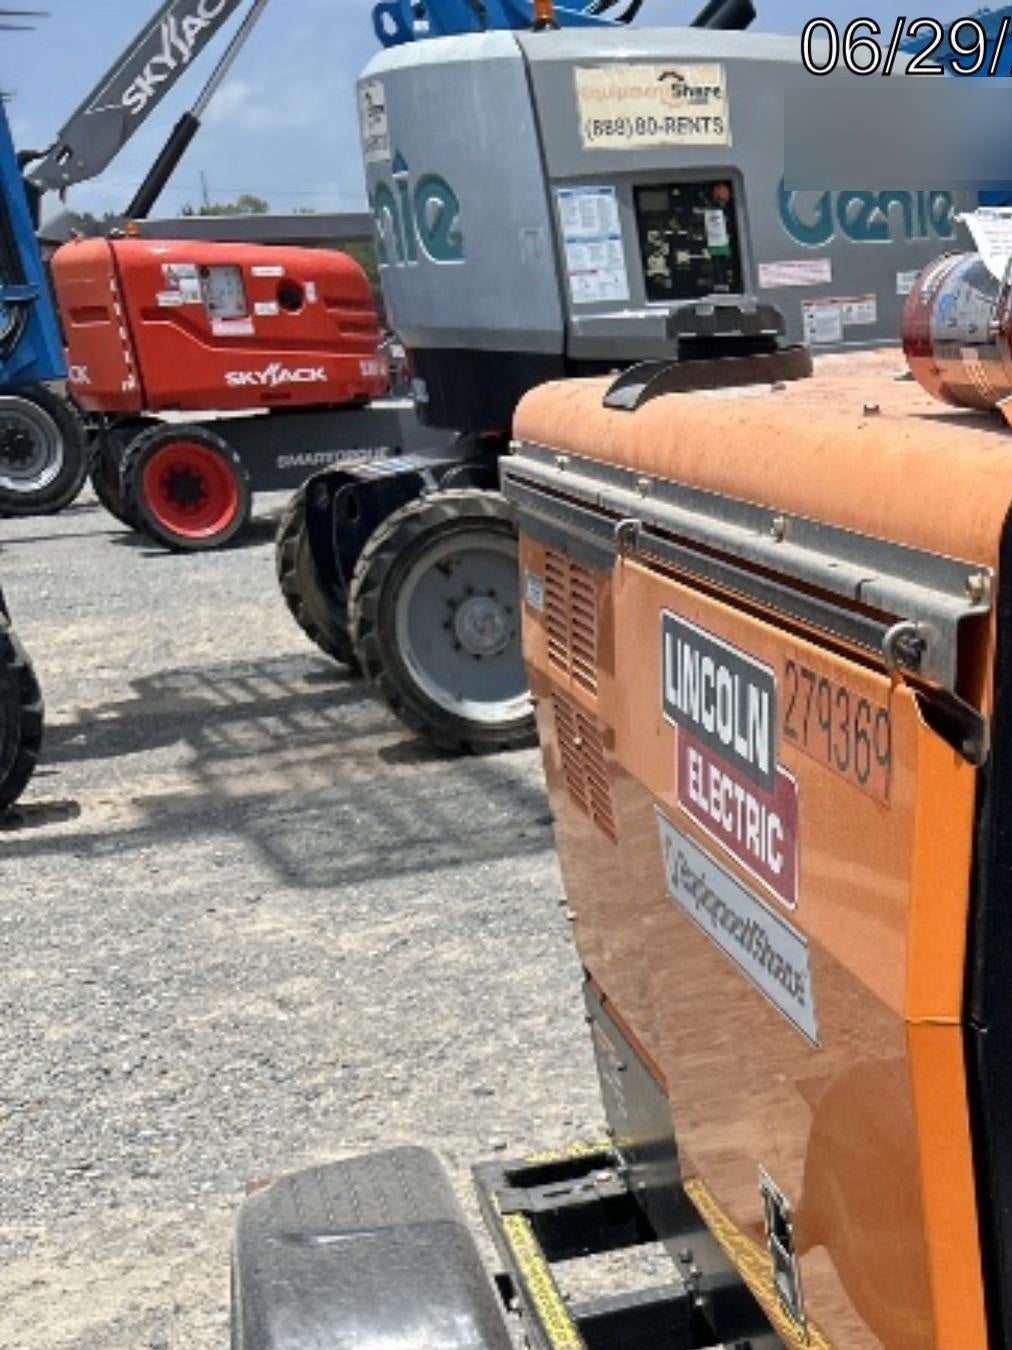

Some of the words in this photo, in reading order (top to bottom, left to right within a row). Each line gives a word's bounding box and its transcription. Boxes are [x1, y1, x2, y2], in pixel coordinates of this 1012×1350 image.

[122, 0, 226, 115] SKYJAC
[224, 362, 328, 388] SKYJACK
[664, 631, 770, 775] LINCOLN
[783, 657, 894, 799] 279369
[685, 747, 785, 875] ELECTRIC
